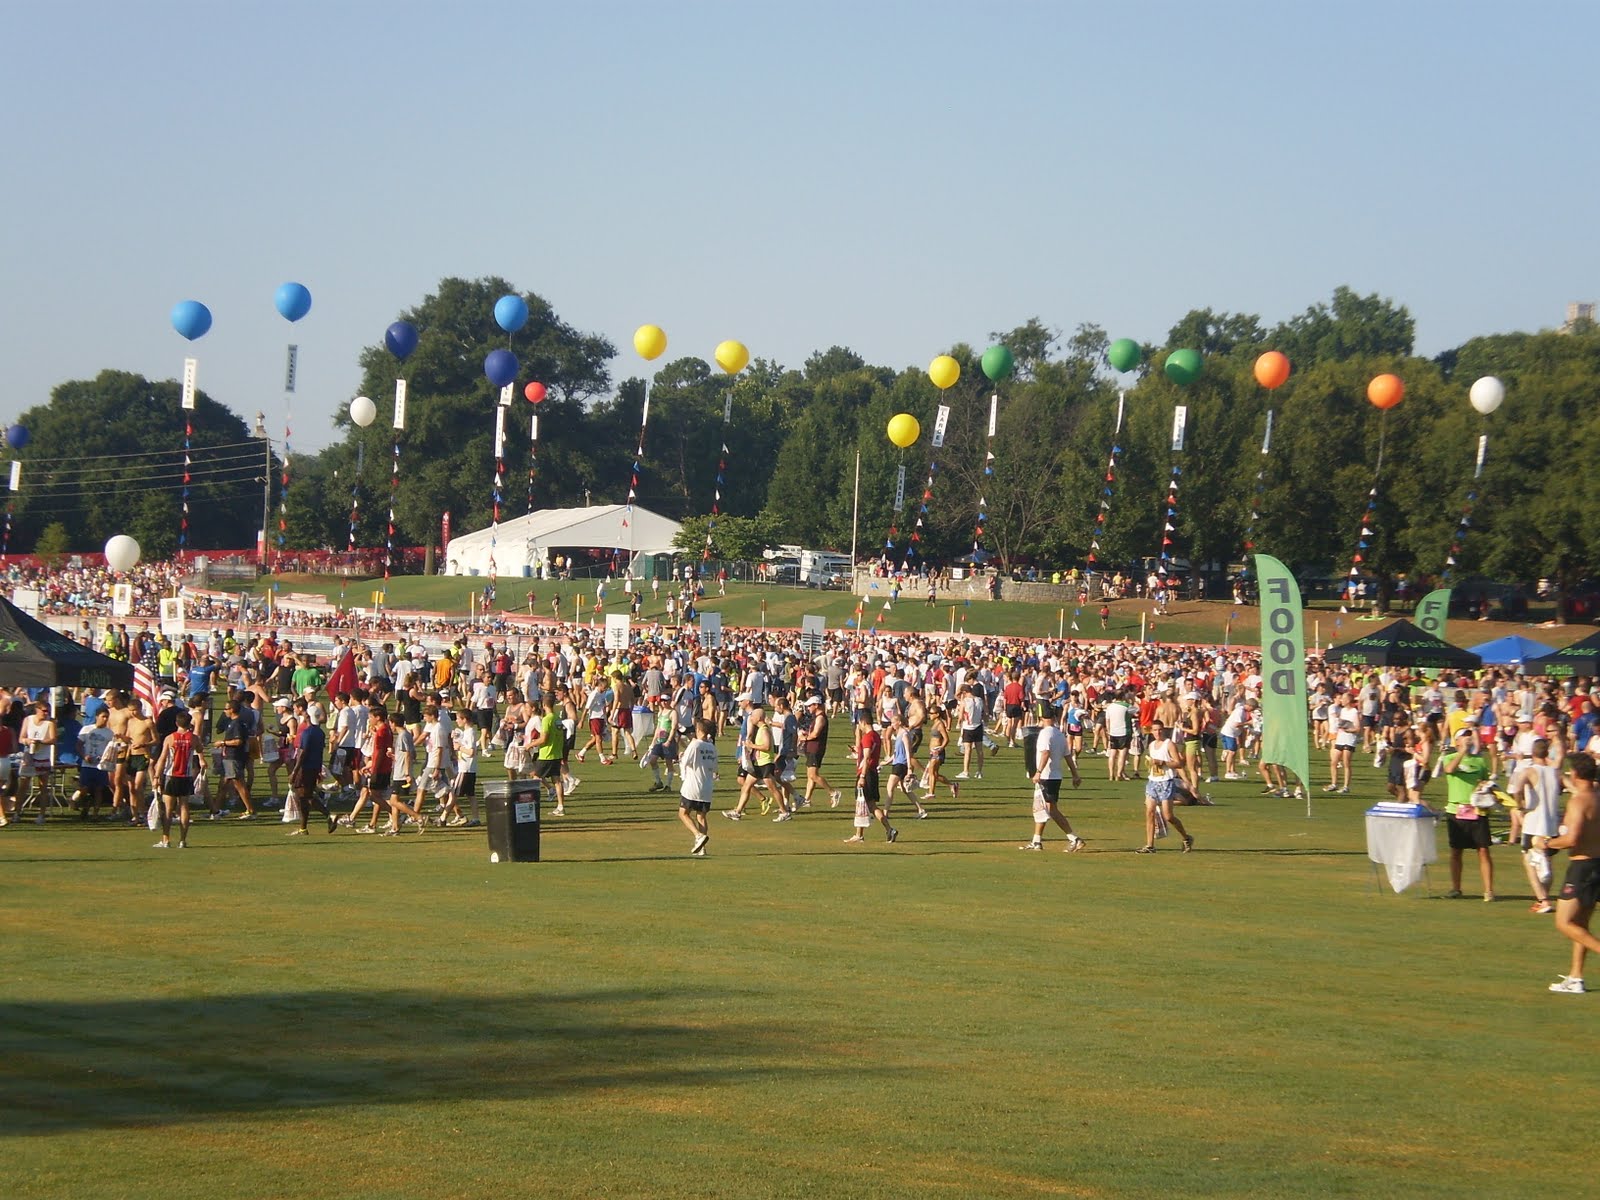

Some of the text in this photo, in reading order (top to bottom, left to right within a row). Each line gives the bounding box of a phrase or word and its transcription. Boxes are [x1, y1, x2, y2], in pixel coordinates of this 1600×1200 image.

[1421, 601, 1441, 631] FO
[1354, 638, 1390, 647] Publix
[1398, 640, 1446, 648] Publix
[1342, 653, 1368, 664] Publix
